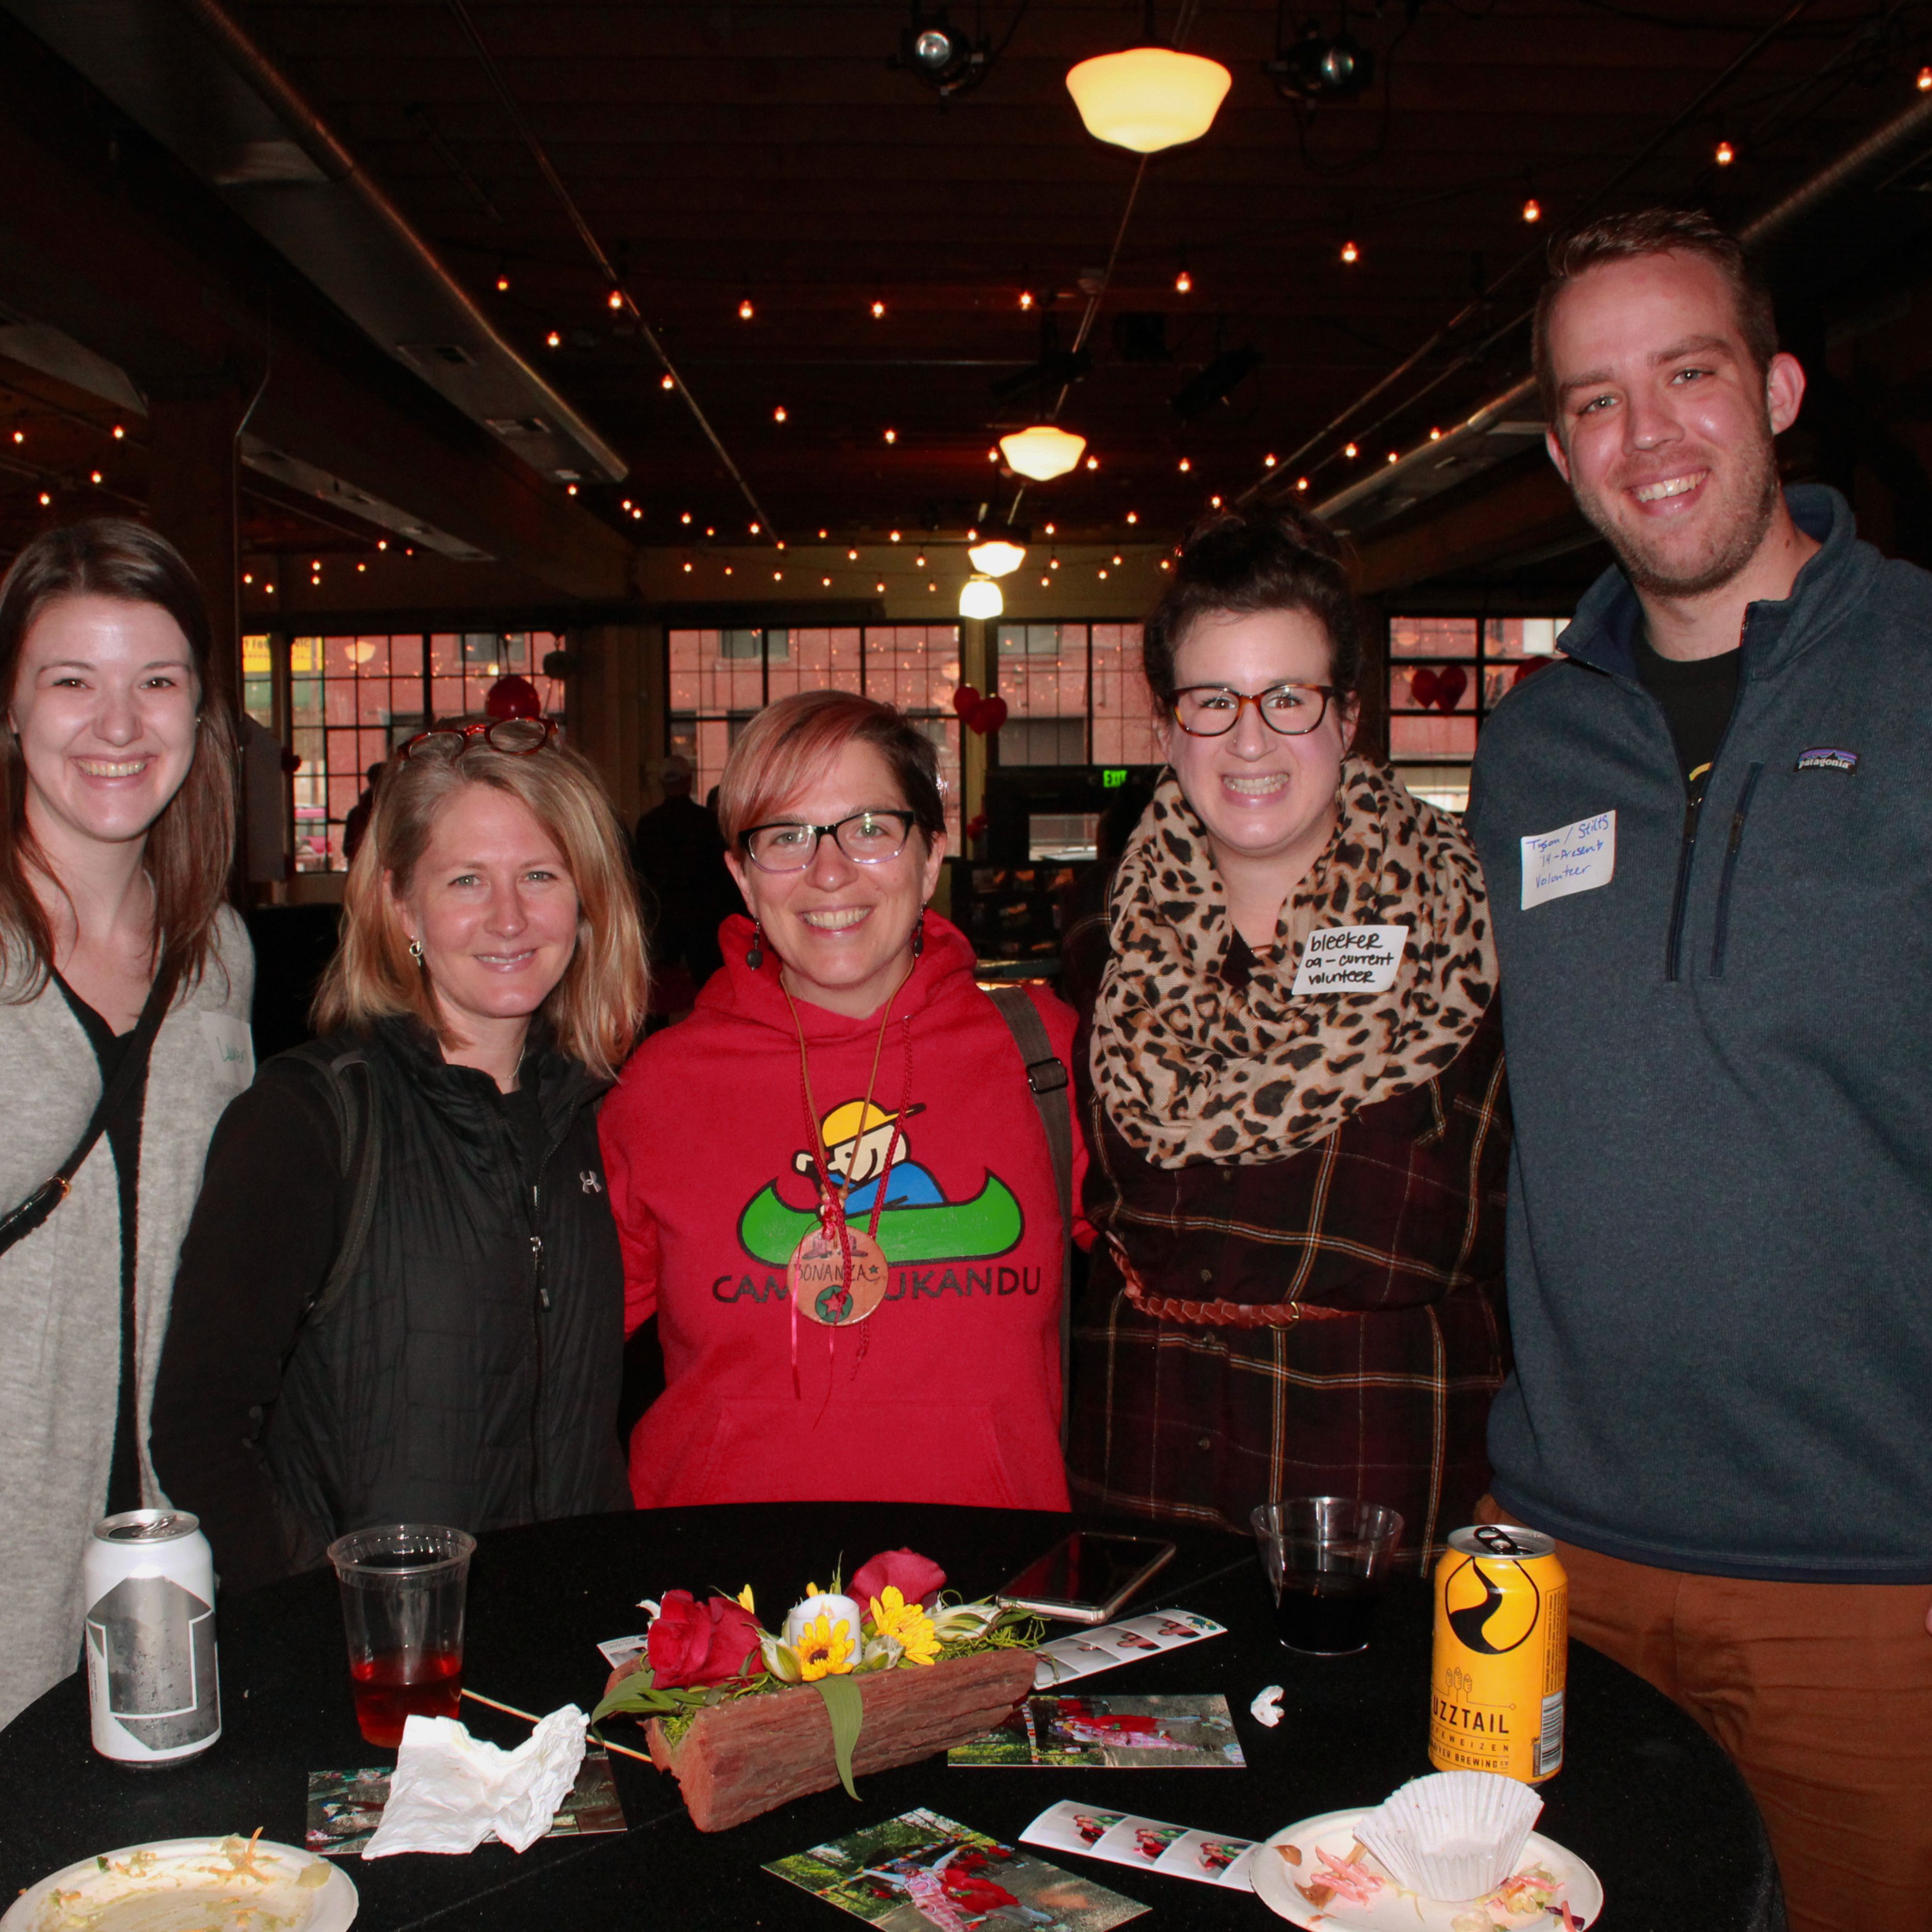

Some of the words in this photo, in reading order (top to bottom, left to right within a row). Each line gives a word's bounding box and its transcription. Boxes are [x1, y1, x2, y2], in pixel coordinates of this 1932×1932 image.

[1798, 758, 1849, 769] patagonia
[712, 1275, 788, 1303] CAM
[1455, 1753, 1498, 1769] BREWING
